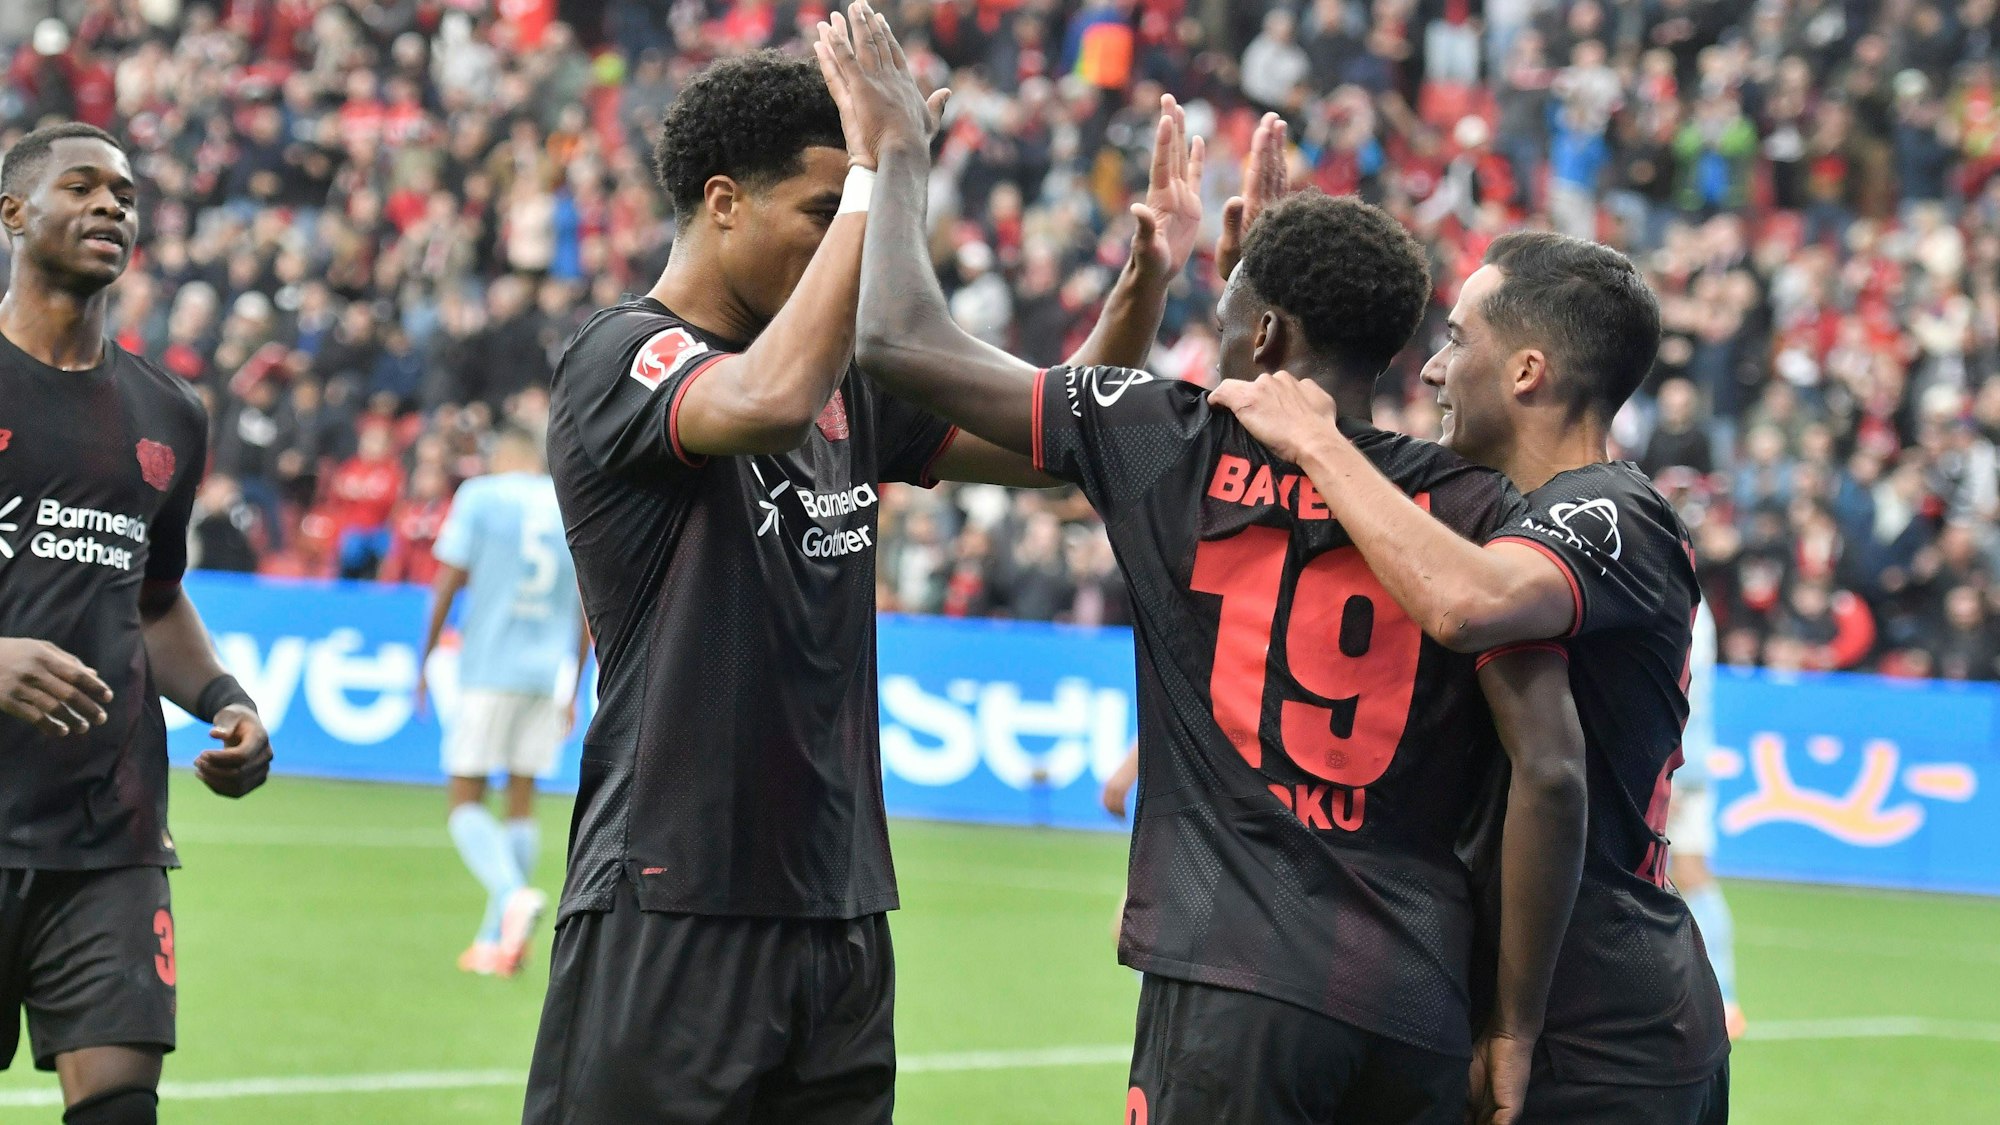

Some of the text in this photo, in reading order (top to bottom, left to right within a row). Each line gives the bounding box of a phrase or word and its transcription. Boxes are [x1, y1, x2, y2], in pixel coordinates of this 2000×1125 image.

[1208, 454, 1338, 520] BAYE
[30, 531, 133, 571] Gothaer
[517, 498, 559, 597] 5
[1190, 524, 1422, 787] 19
[153, 908, 176, 986] 3
